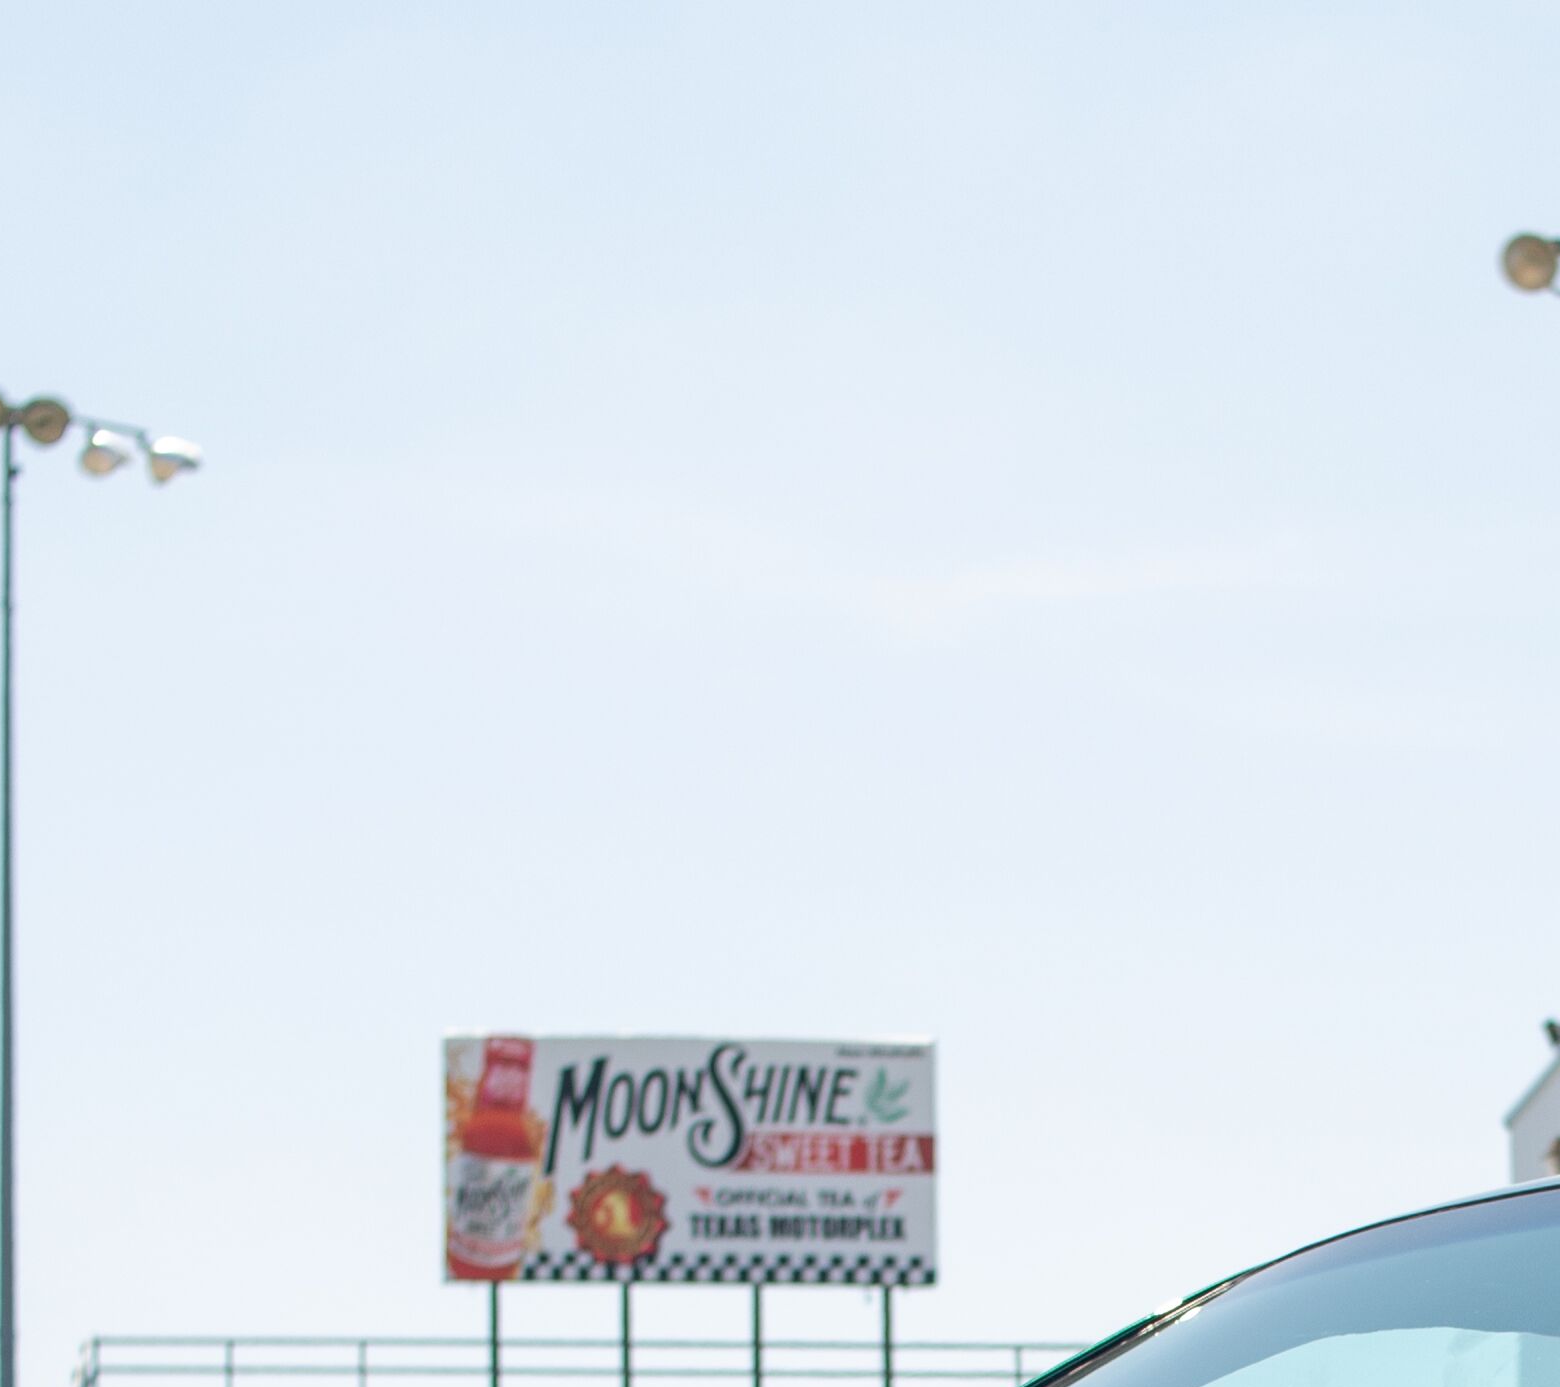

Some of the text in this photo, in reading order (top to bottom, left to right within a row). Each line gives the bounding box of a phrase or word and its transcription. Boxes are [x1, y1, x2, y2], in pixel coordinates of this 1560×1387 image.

[750, 1132, 925, 1172] SWEET TEA
[817, 1189, 855, 1207] TEA
[690, 1212, 907, 1241] TEXAS MOTORPLEX
